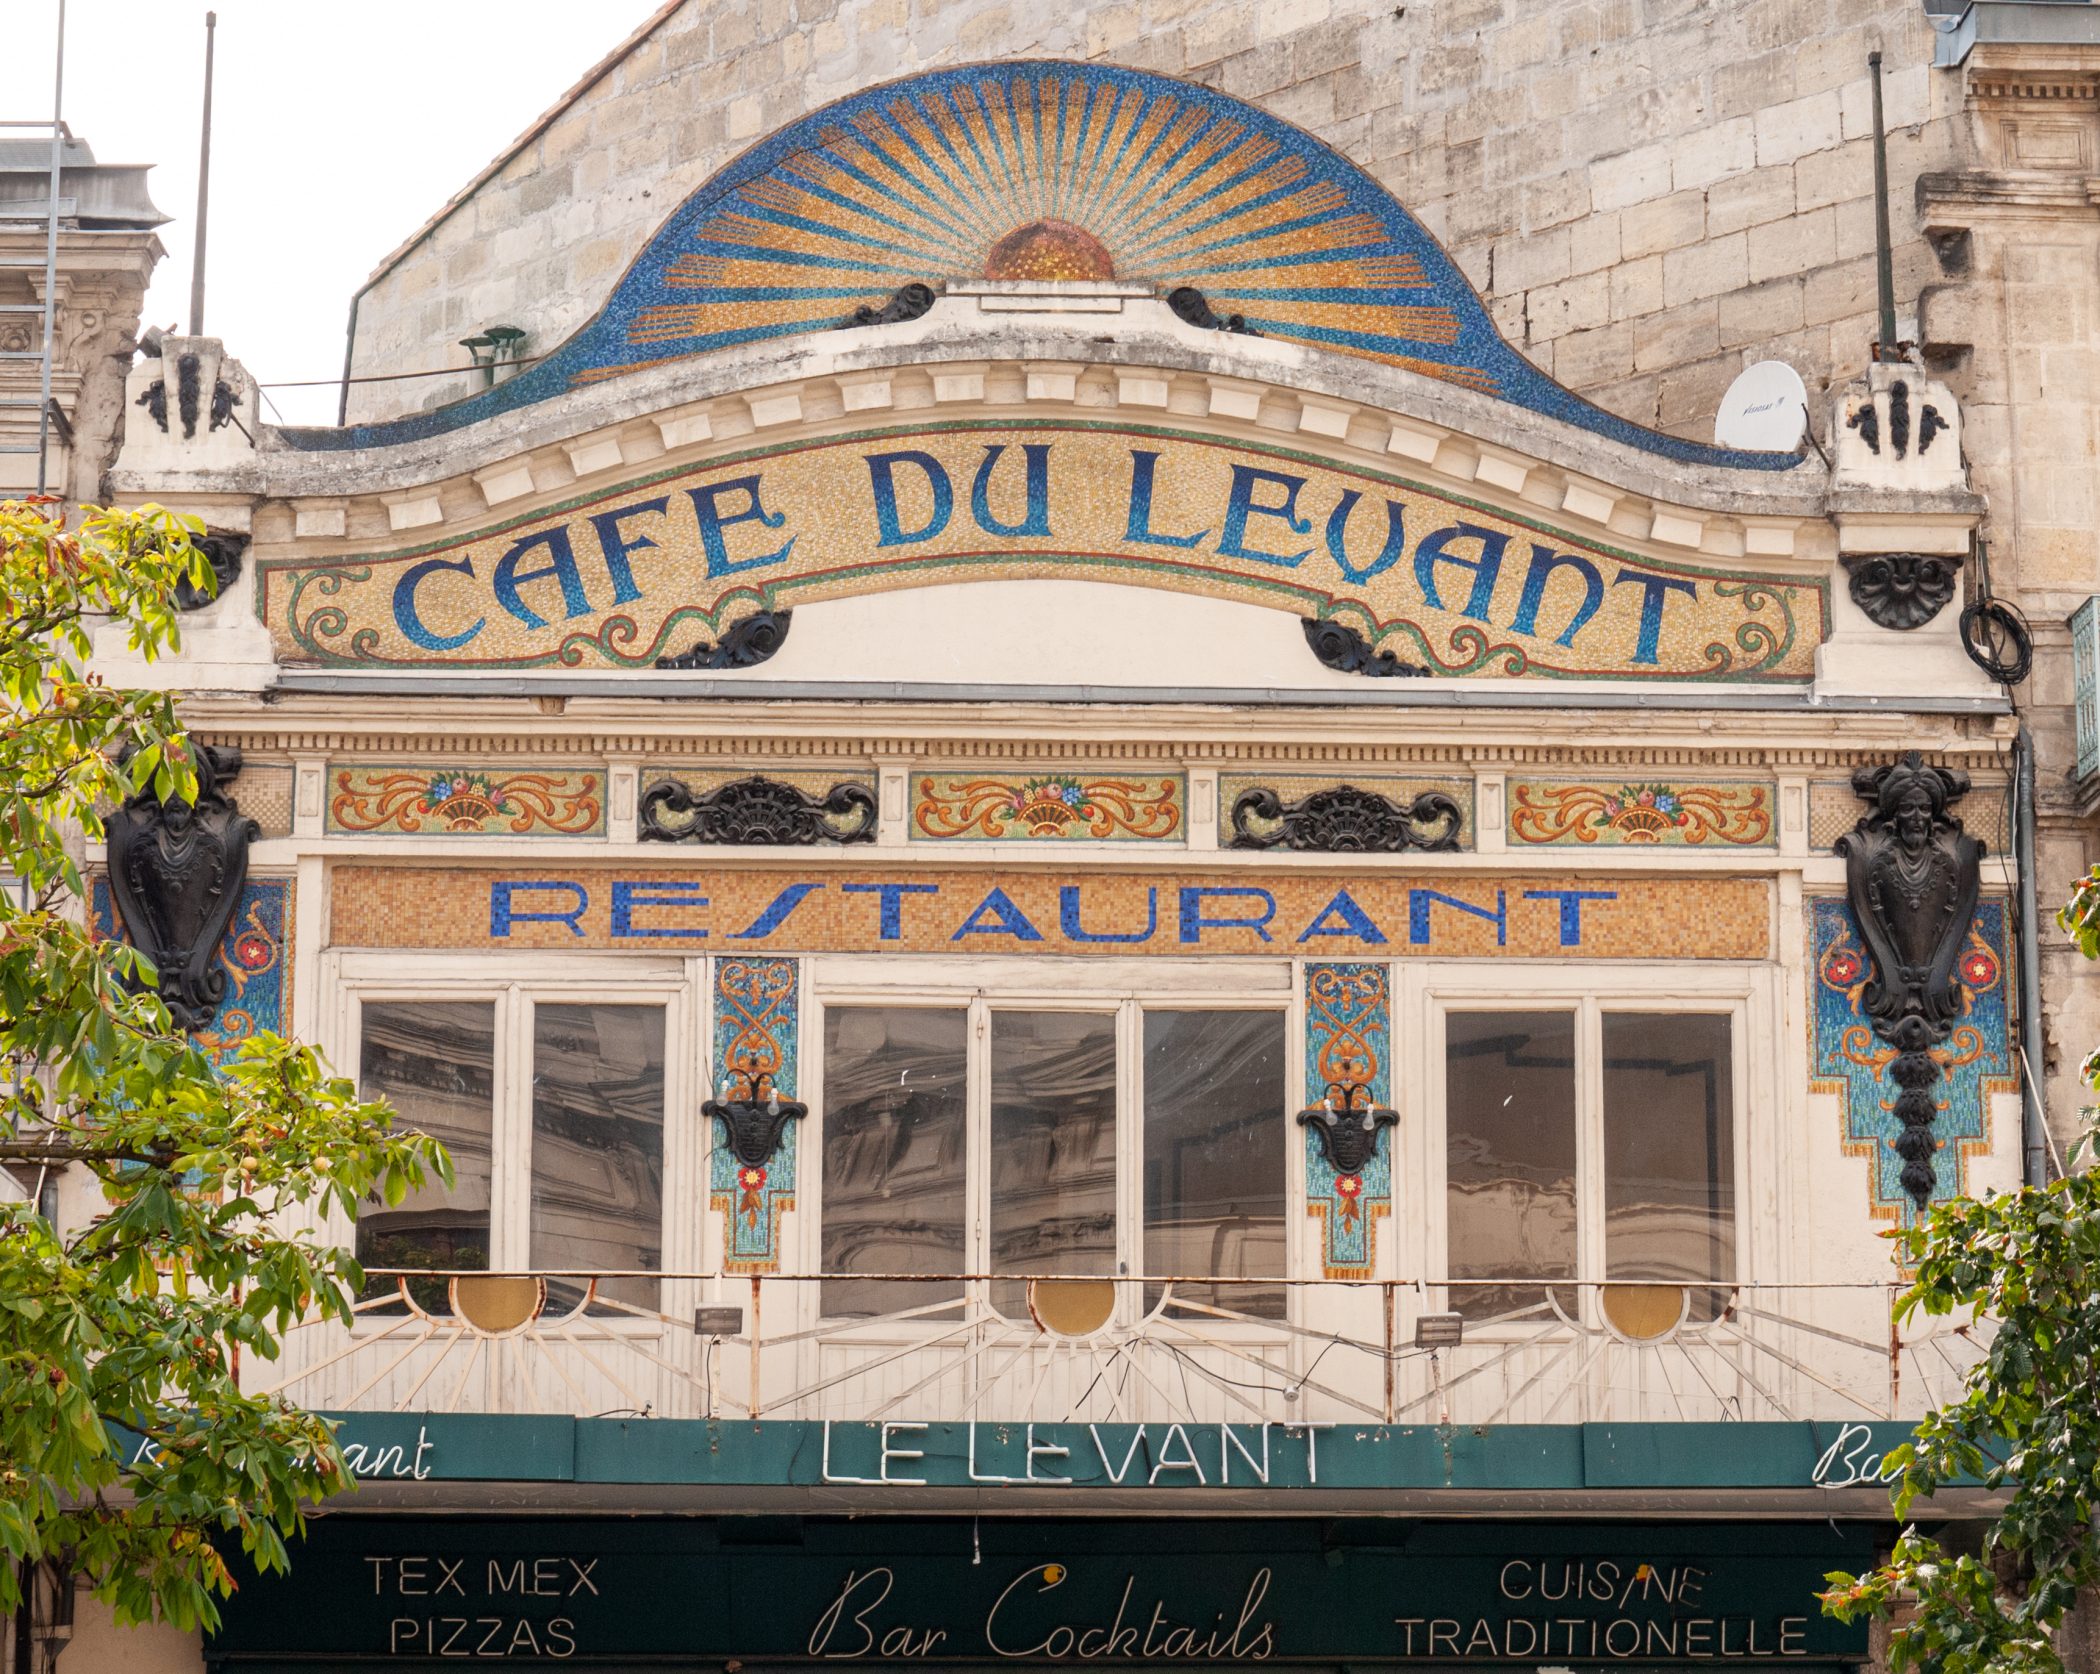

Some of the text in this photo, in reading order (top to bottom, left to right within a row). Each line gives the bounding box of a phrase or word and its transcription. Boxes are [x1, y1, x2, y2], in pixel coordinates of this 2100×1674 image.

[392, 444, 1697, 664] CAFE DU LEVANT
[489, 880, 1617, 946] RESTAURANT
[823, 1419, 1337, 1486] LE LEVANT
[1811, 1422, 1907, 1489] Ba
[364, 1557, 599, 1597] TEX MEX
[1500, 1560, 1705, 1609] CUISINE
[391, 1618, 576, 1657] PIZZAS
[808, 1563, 1276, 1659] Bar Cocktails
[1395, 1617, 1808, 1657] TRADITIONELLE
